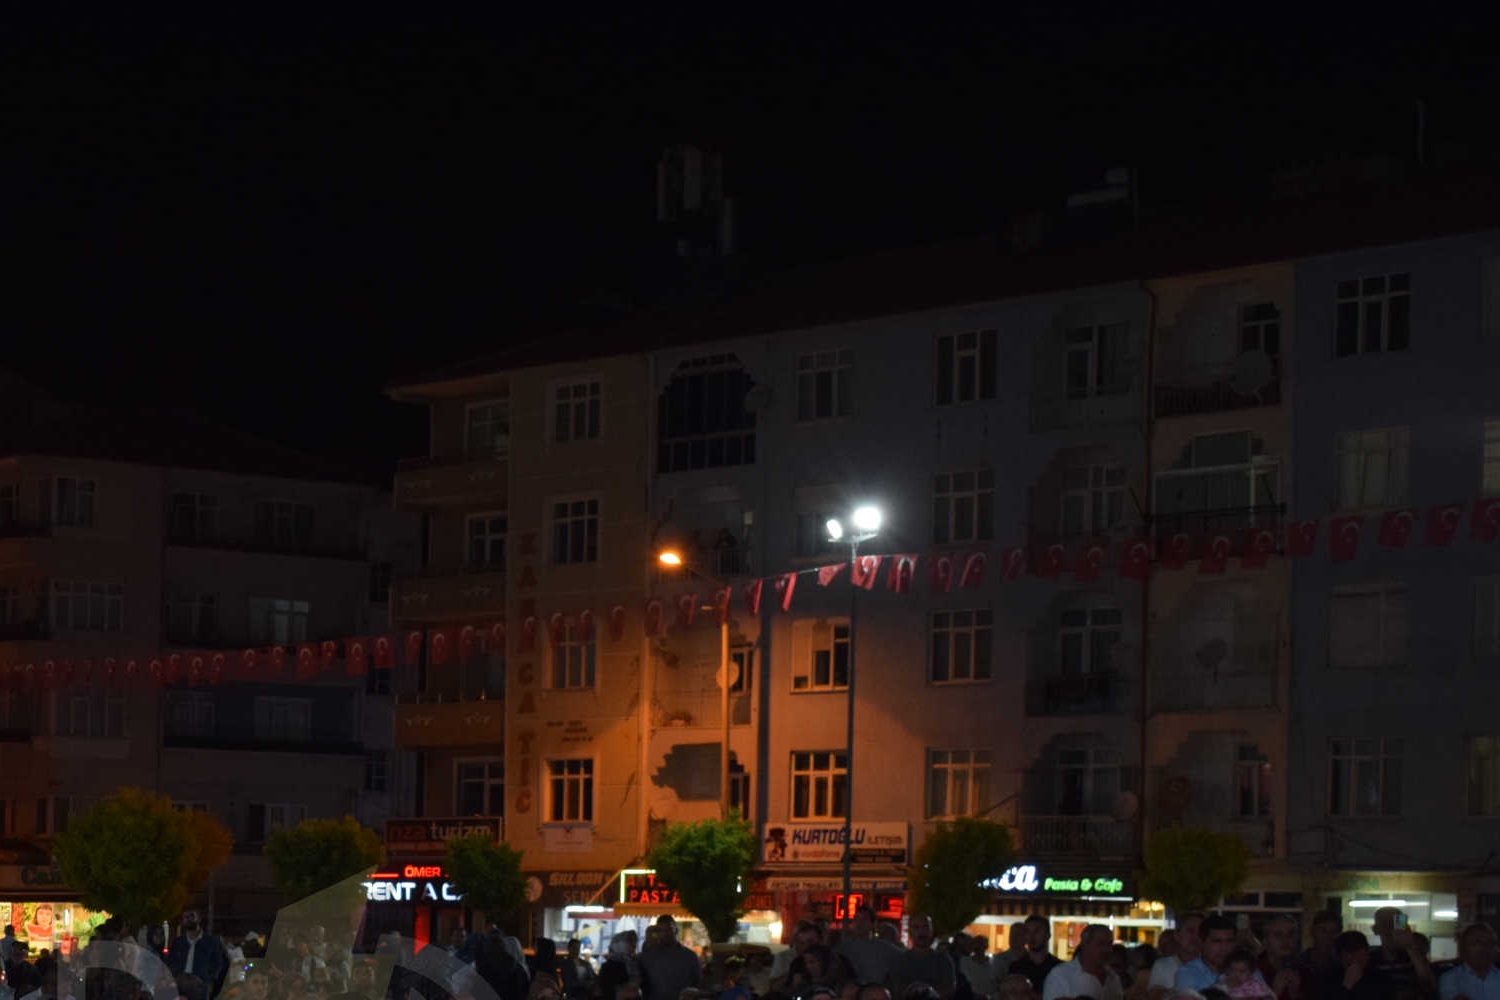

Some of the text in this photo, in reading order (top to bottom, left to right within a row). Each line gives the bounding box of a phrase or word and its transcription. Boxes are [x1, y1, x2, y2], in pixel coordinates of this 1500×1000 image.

[404, 864, 443, 878] ÖMER
[1080, 877, 1092, 892] &
[1094, 877, 1124, 894] Cafe
